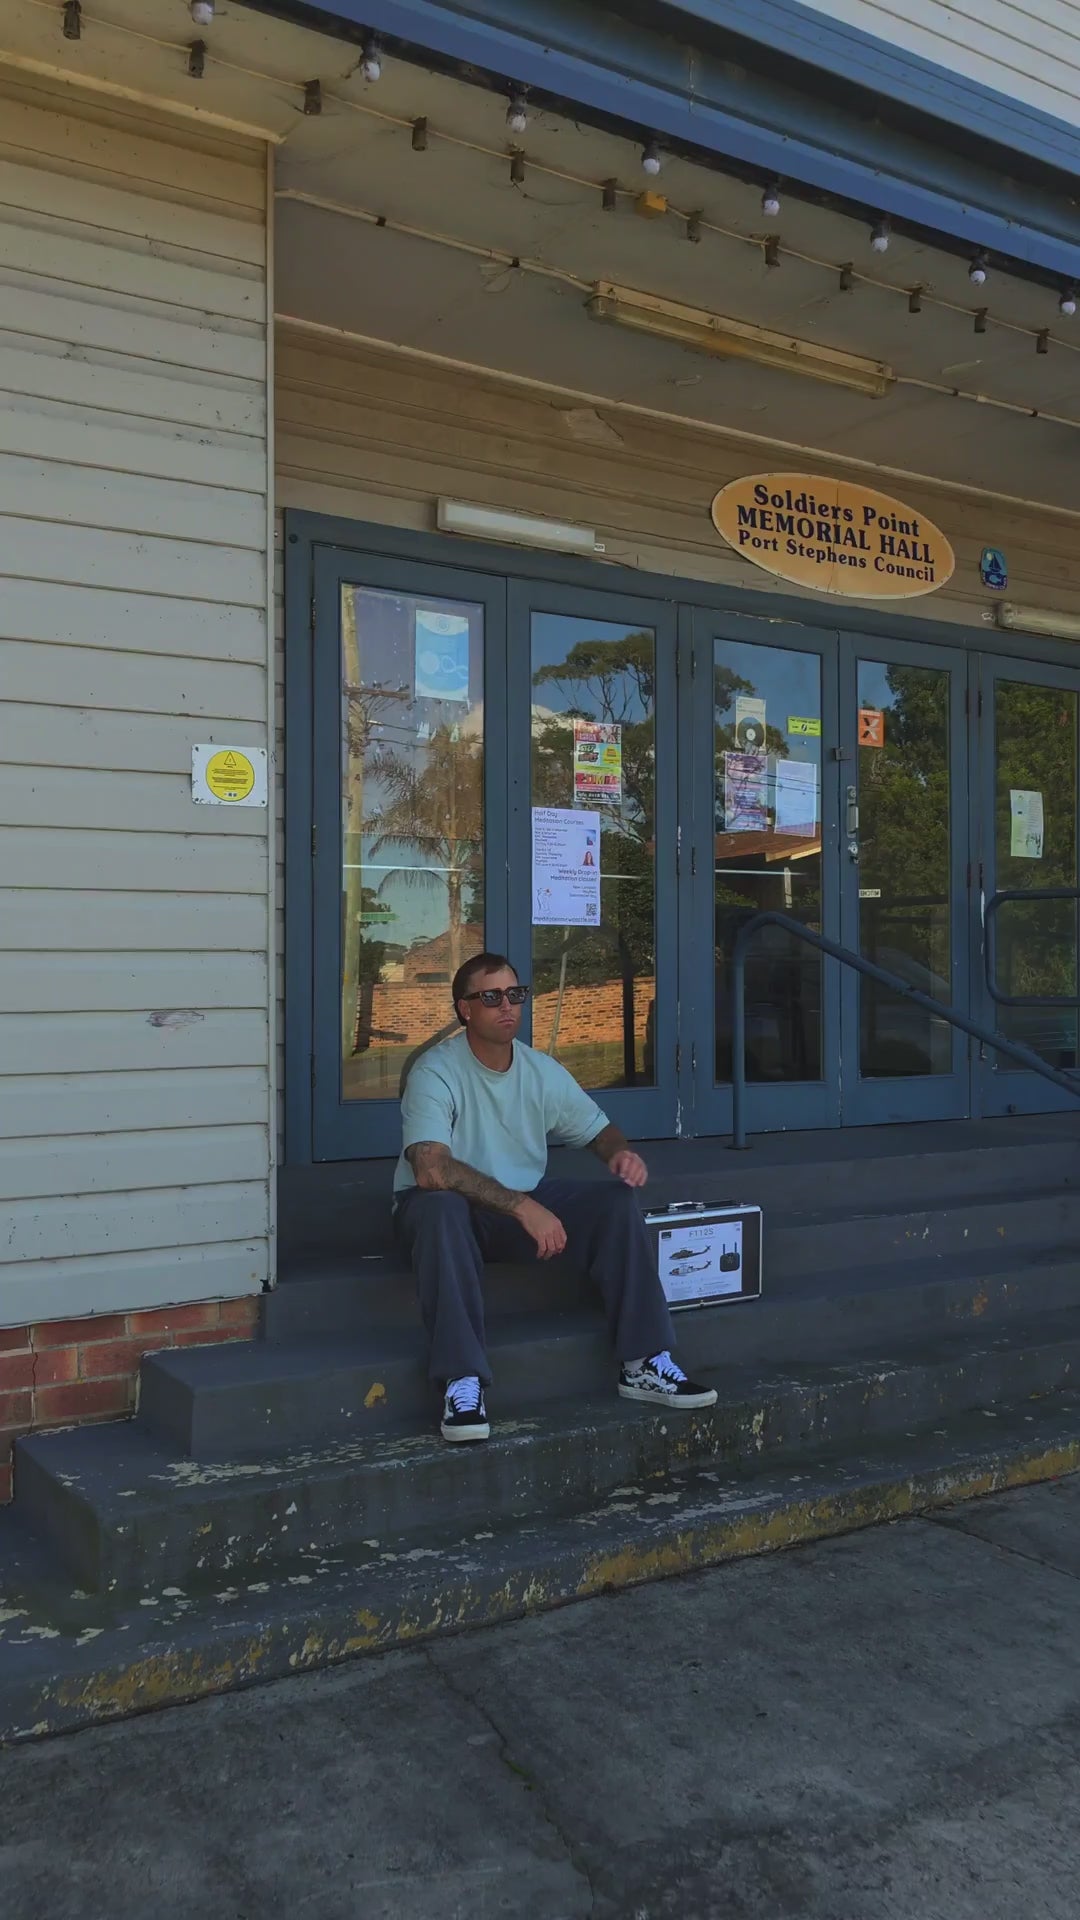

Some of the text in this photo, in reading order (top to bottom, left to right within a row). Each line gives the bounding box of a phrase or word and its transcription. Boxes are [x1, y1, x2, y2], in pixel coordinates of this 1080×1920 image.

[737, 504, 935, 564] MEMORIAL HALL
[754, 484, 920, 537] Soldiers Point
[738, 529, 935, 582] Port Stephens Council
